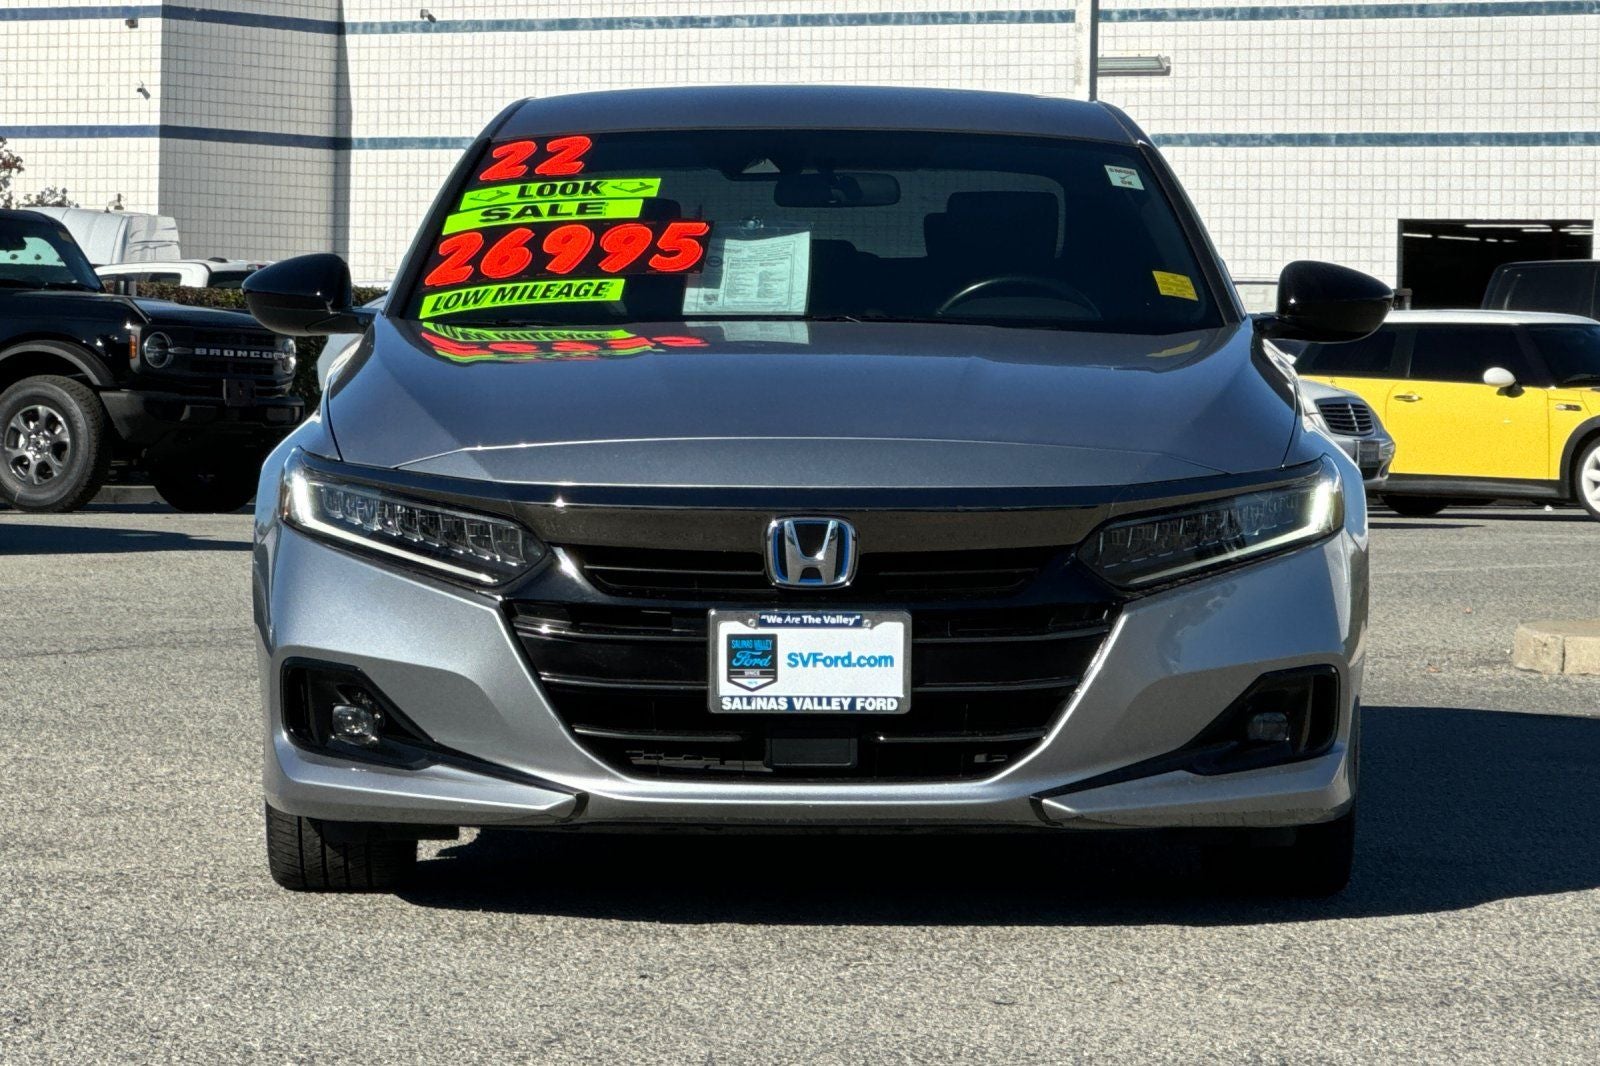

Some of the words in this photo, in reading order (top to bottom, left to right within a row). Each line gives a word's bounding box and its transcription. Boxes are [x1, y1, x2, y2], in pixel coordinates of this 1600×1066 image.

[479, 136, 592, 181] 22
[517, 179, 605, 199] LOOK
[480, 200, 607, 223] SALE
[424, 222, 709, 287] 26995
[430, 288, 493, 313] LOW
[494, 280, 608, 302] MILEAGE
[194, 347, 273, 359] BRONCO
[783, 614, 801, 625] Are
[802, 614, 822, 625] The
[732, 650, 772, 667] Ford
[786, 651, 895, 668] SVFord.com
[721, 697, 789, 711] SALINAS
[792, 697, 853, 711] VALLEY
[855, 697, 899, 711] FORD
